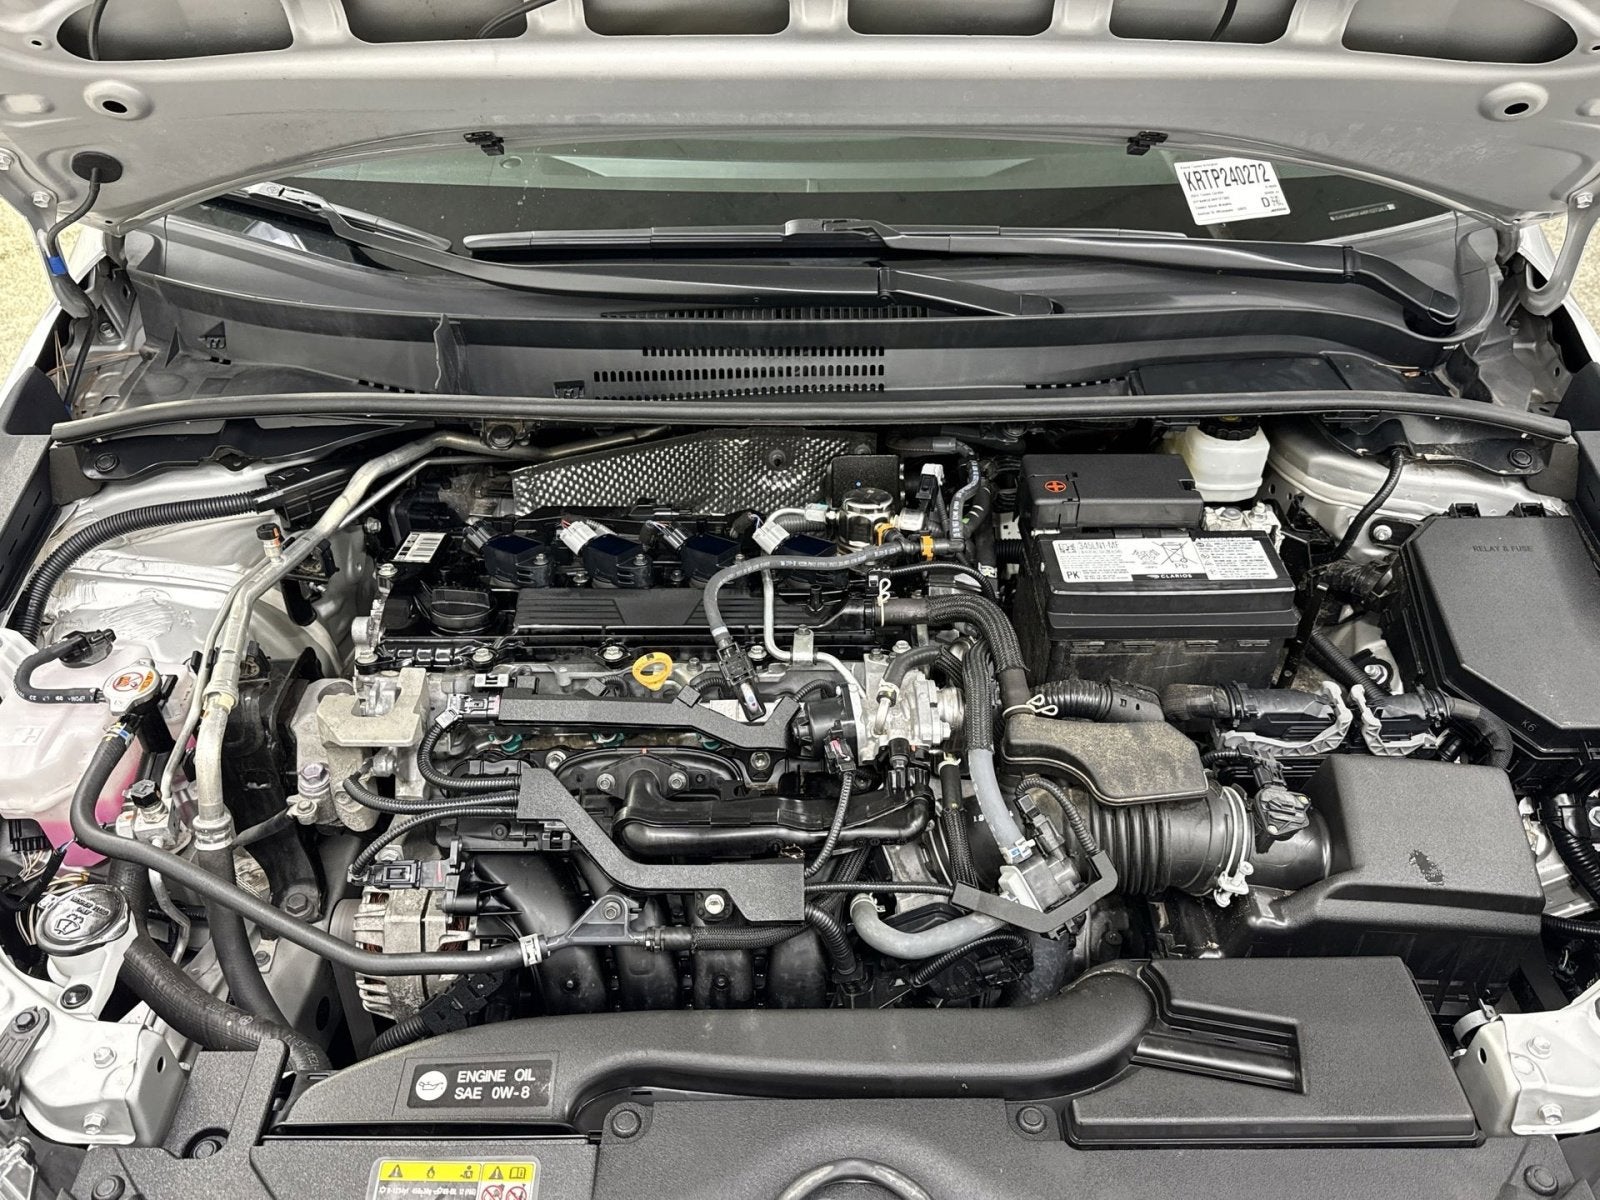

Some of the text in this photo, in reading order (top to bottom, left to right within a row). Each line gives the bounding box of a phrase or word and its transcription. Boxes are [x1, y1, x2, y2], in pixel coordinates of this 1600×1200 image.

[1183, 163, 1271, 192] KRTP240272
[1261, 197, 1271, 208] D
[1066, 570, 1080, 579] PK
[456, 1068, 536, 1083] ENGINE OIL
[454, 1086, 530, 1099] SAE 0W-8
